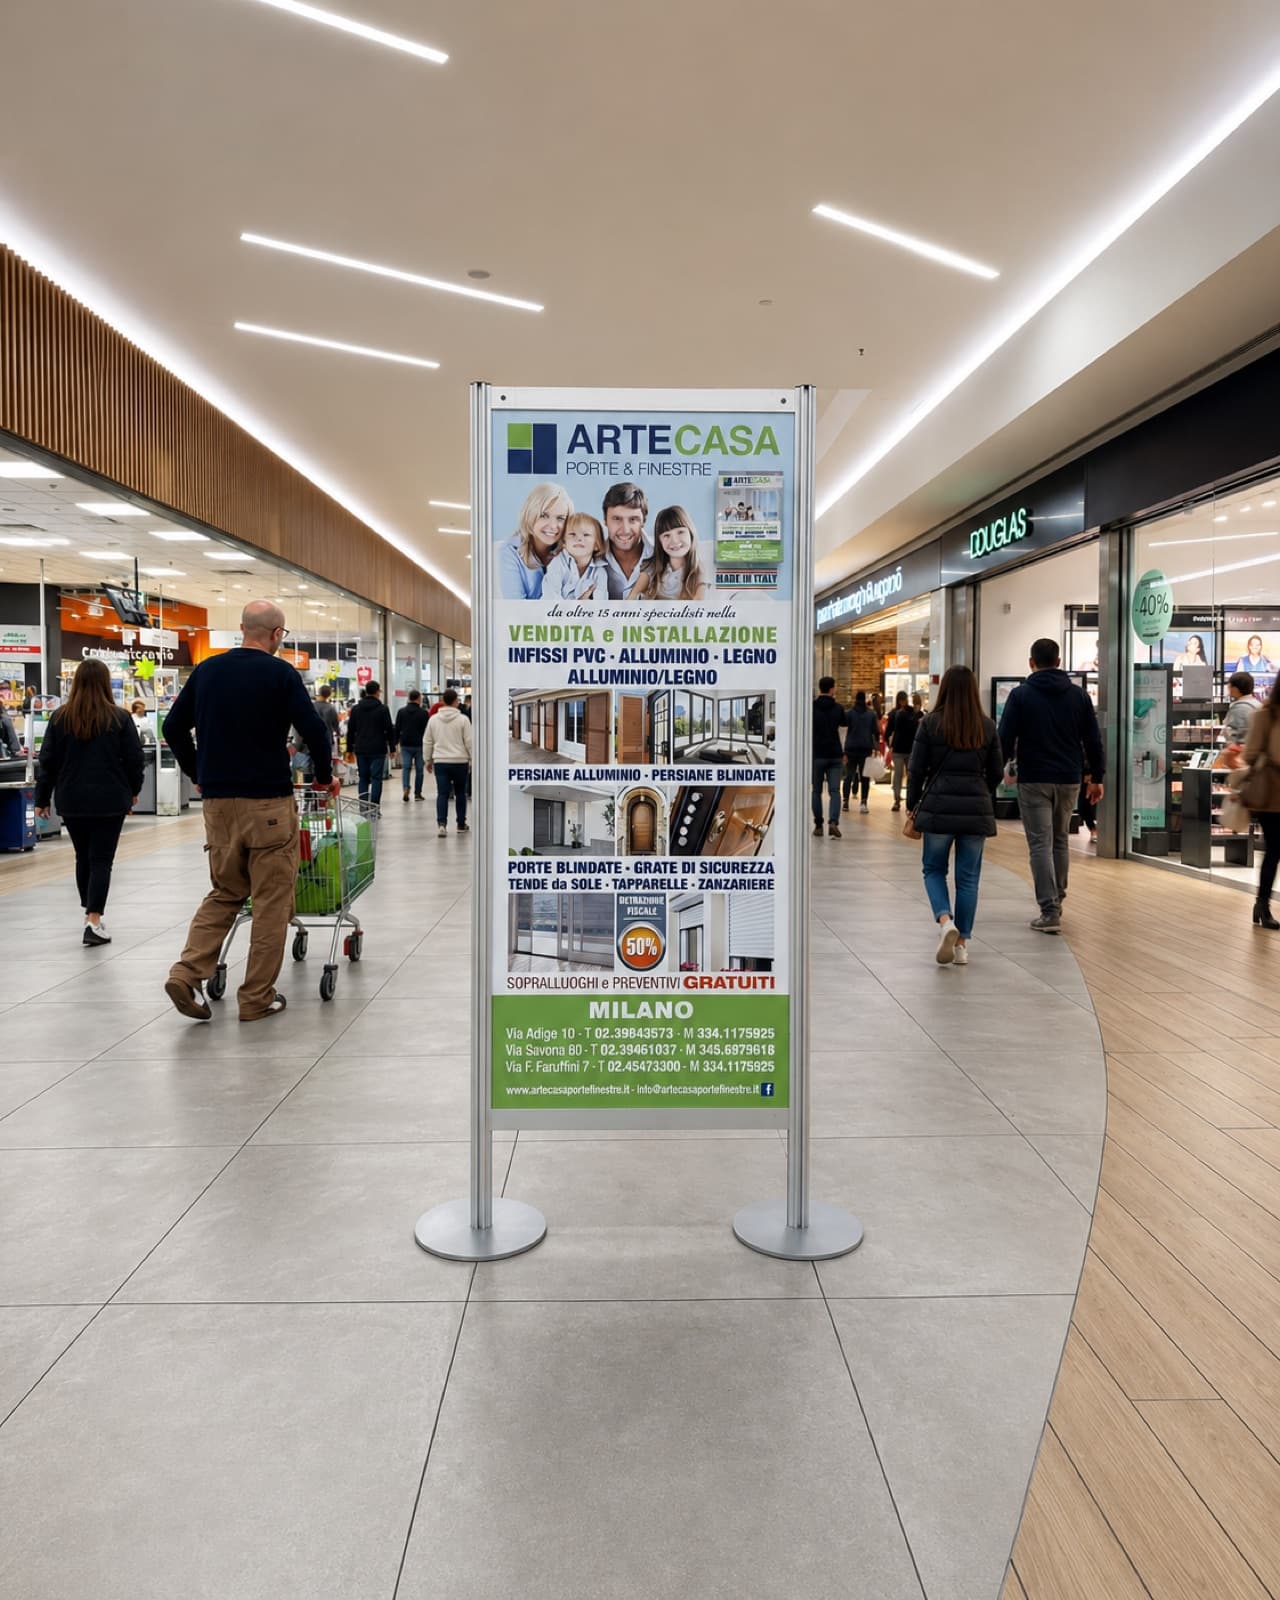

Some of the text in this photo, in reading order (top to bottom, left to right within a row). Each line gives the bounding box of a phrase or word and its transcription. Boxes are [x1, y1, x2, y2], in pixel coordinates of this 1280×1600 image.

[567, 424, 780, 456] ARTECASA
[566, 462, 712, 476] PORTE & FINESTRE
[969, 507, 1027, 559] DOUGLAS
[547, 605, 736, 621] da oltre 15 anni specialisti nella
[509, 625, 777, 643] VENDITA e INSTALLAZIONE
[509, 647, 776, 664] INFISSI PVC ALLUMINIO LEGNO
[568, 669, 717, 685] ALLUMINIO/LEGNO
[508, 769, 775, 781] PERSIANE ALLUMINIO PERSIANE BLINDATE
[508, 861, 774, 875] PORTE BLINDATE GRATE DI SICUREZZA
[509, 879, 774, 890] TENDE da SOLE TAPPARELLE ZANZARIERE
[626, 937, 657, 956] 50%
[507, 976, 775, 989] SOPRALLUOGHI e PREVENTIVI GRATUITI
[589, 1001, 694, 1019] MILANO
[506, 1027, 523, 1039] Via
[526, 1027, 558, 1042] Adige
[561, 1027, 575, 1039] 10
[584, 1027, 591, 1039] T
[684, 1027, 693, 1039] M
[506, 1044, 522, 1056] Via
[526, 1044, 565, 1056] Savona
[591, 1044, 598, 1055] T
[686, 1044, 696, 1055] M
[506, 1061, 521, 1073] Via
[525, 1061, 533, 1072] F.
[536, 1061, 579, 1073] Faruffini
[583, 1061, 589, 1072] 7
[598, 1061, 605, 1072] T
[690, 1061, 699, 1072] M
